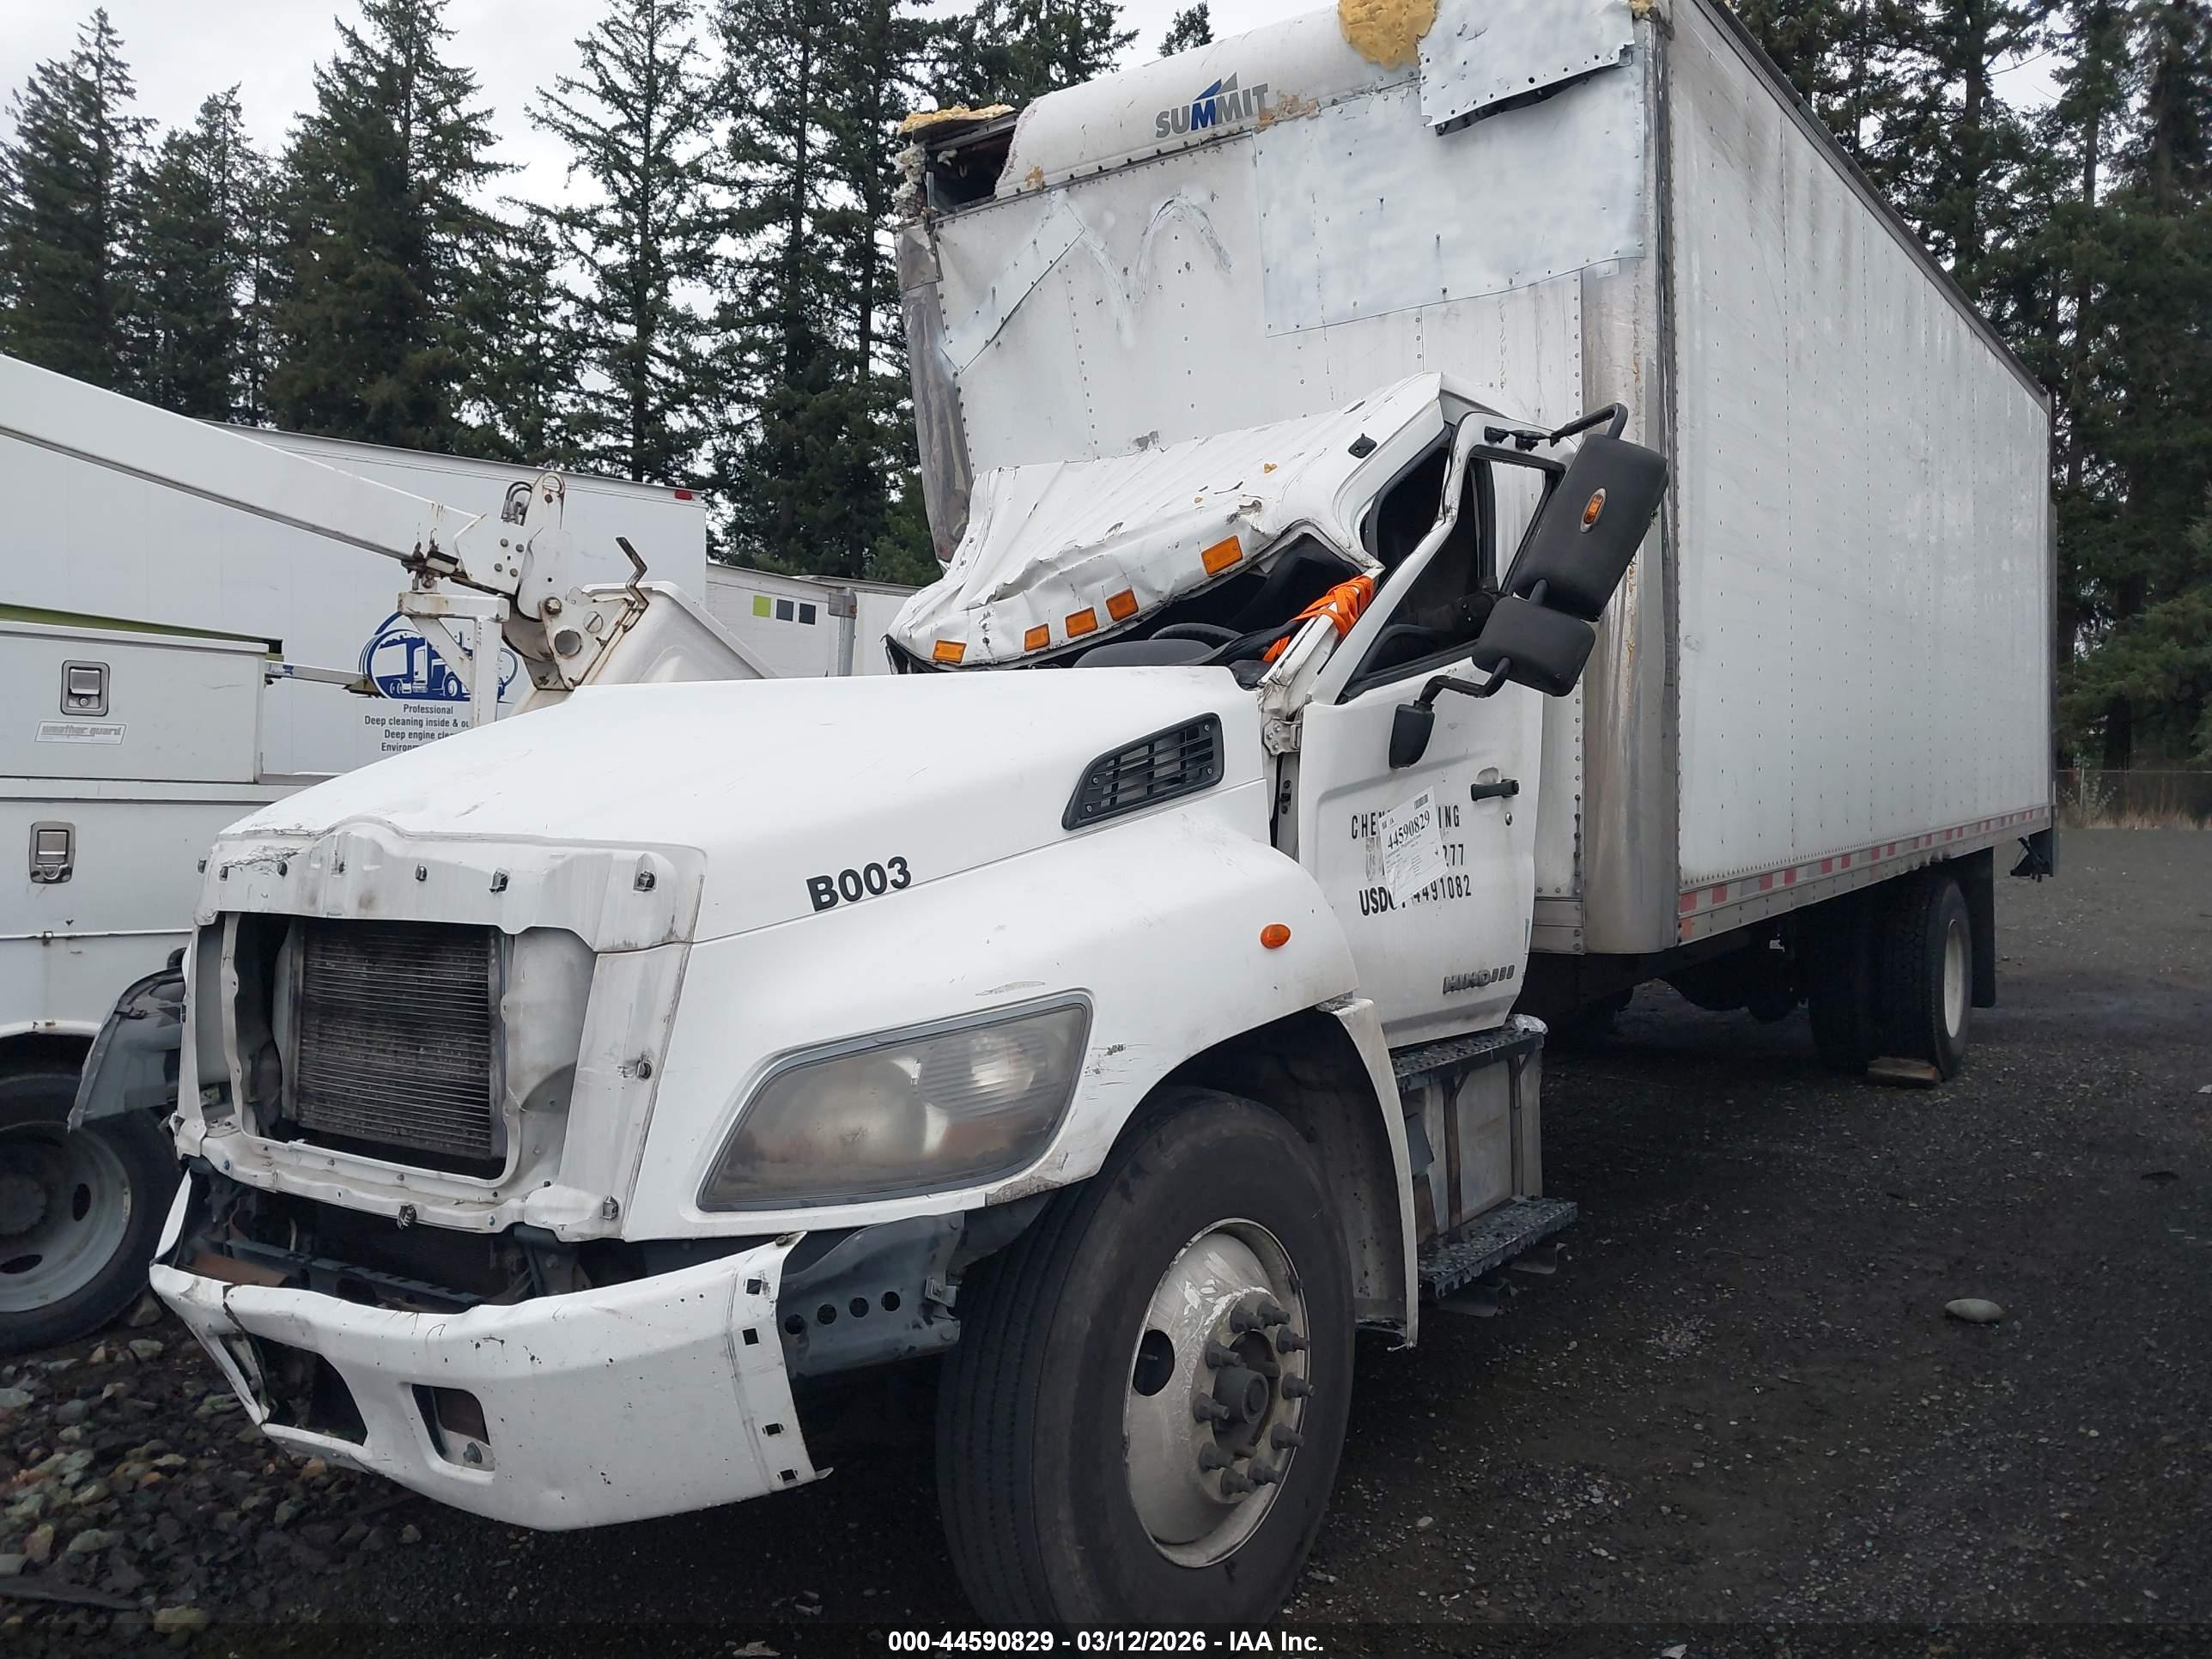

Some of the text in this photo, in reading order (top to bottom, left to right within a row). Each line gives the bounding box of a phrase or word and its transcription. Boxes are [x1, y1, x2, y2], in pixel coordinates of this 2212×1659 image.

[1156, 82, 1268, 138] SUMMIT
[403, 703, 453, 714] Professional
[364, 715, 386, 727] Deep
[388, 716, 423, 728] cleaning
[425, 718, 450, 727] inside
[452, 719, 459, 727] &
[384, 729, 406, 739] Deep
[407, 730, 435, 741] engine
[1437, 805, 1461, 829] ING
[1387, 810, 1431, 850] 44590829
[805, 855, 912, 913] B003
